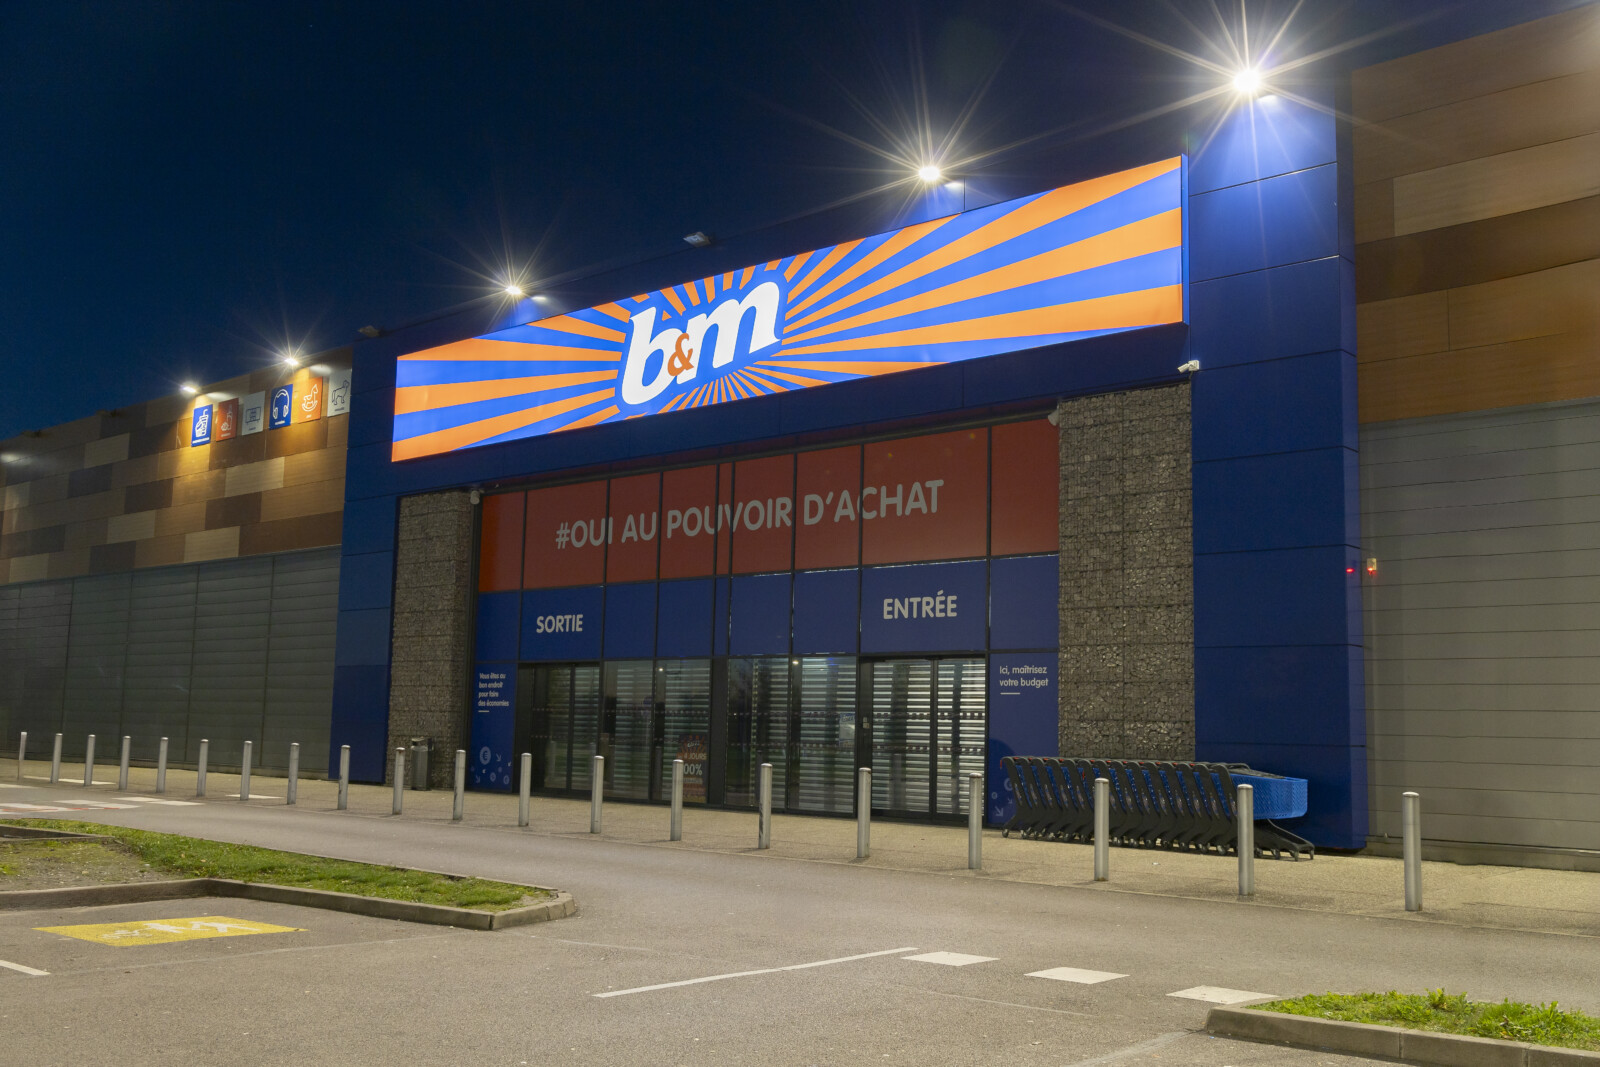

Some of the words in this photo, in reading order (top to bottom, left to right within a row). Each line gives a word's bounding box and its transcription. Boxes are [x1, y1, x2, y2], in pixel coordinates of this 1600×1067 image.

[622, 281, 781, 405] b&m
[555, 515, 614, 549] #OUI
[621, 511, 657, 543] AU
[666, 497, 792, 539] POUVOIR
[803, 479, 945, 526] D'ACHAT
[883, 589, 958, 620] ENTRÉE
[536, 614, 584, 633] SORTIE
[999, 665, 1010, 676] Ici,
[1012, 664, 1048, 674] maîtrisez
[999, 678, 1019, 687] votre
[1020, 677, 1049, 689] budget
[489, 690, 499, 698] faire
[478, 699, 486, 707] des
[486, 699, 510, 707] économies
[683, 763, 703, 776] 00%
